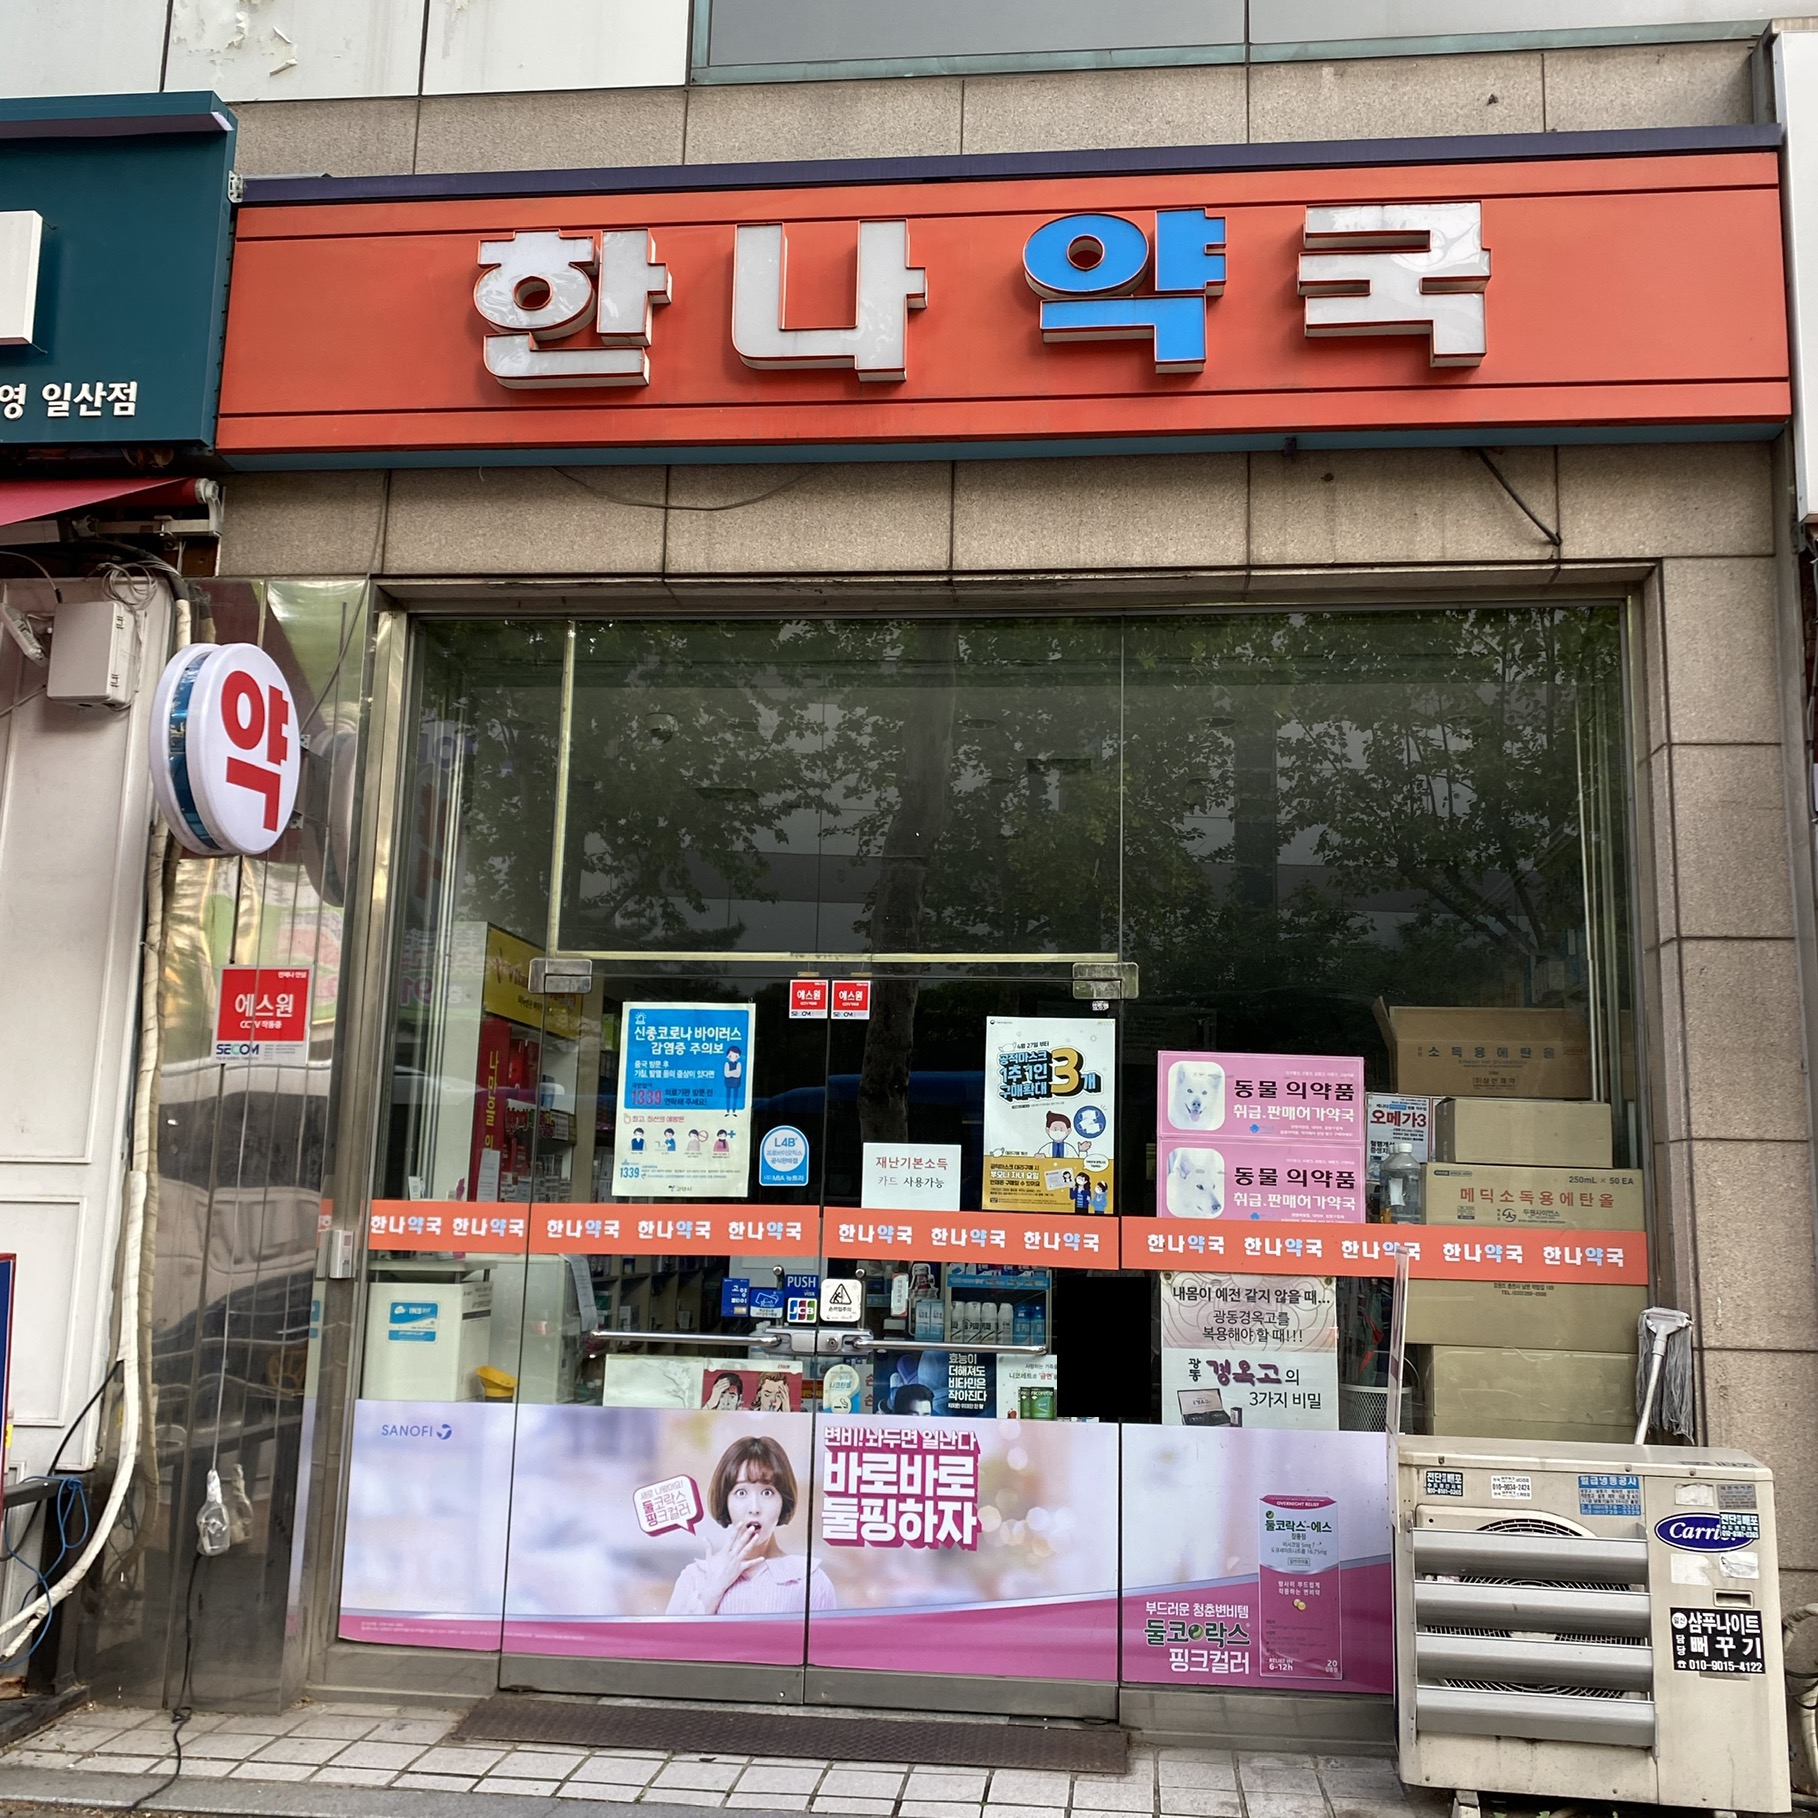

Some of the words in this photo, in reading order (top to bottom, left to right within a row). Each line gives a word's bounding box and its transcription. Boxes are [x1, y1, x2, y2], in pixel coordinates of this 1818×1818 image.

[42, 380, 137, 417] 일산점
[221, 670, 289, 832] 약
[796, 989, 821, 1001] 에스원
[838, 990, 863, 1001] 에스원
[234, 993, 294, 1018] 에스원
[261, 1020, 282, 1029] 작동중
[634, 1026, 693, 1041] 신종코로나
[694, 1026, 742, 1041] 바이러스
[216, 1043, 260, 1055] SECOM
[651, 1042, 686, 1055] 감염증
[689, 1042, 724, 1055] 주의보
[999, 1050, 1048, 1065] 공적마스크
[696, 1070, 715, 1079] 있다면
[1025, 1063, 1048, 1080] 1인
[631, 1089, 662, 1106] 1339
[999, 1081, 1047, 1099] 구매확대
[1234, 1079, 1278, 1099] 동물
[1285, 1081, 1355, 1102] 의약품
[1233, 1104, 1355, 1123] 취급.판매허가약국
[1370, 1109, 1427, 1128] 오메가3
[774, 1137, 796, 1148] L4B
[875, 1156, 949, 1170] 재난기본소득
[619, 1167, 640, 1179] 1339
[1234, 1167, 1279, 1187] 동물
[1286, 1168, 1356, 1189] 의약품
[1568, 1175, 1598, 1184] 250mL
[1622, 1177, 1634, 1185] EA
[903, 1176, 945, 1189] 사용가능
[1233, 1191, 1356, 1211] 취급.판매허가약국
[370, 1215, 442, 1235] 한나약국
[452, 1217, 525, 1238] 한나약국
[547, 1219, 620, 1239] 한나약국
[637, 1219, 711, 1240] 한나약국
[728, 1221, 802, 1241] 한나약국
[838, 1223, 913, 1245] 한나약국
[931, 1227, 1006, 1248] 한나약국
[1023, 1230, 1100, 1253] 한나약국
[1148, 1234, 1225, 1255] 한나약국
[1243, 1236, 1323, 1258] 한나약국
[1341, 1239, 1421, 1262] 한나약국
[1442, 1242, 1523, 1265] 한나약국
[1543, 1245, 1624, 1268] 한나약국
[787, 1276, 817, 1288] PUSH
[1173, 1286, 1211, 1303] 내몸이
[1215, 1287, 1241, 1303] 예전
[1244, 1288, 1270, 1304] 같지
[1274, 1289, 1301, 1305] 않을
[789, 1303, 816, 1318] JCB
[1213, 1309, 1290, 1327] 광동경옥고를
[1202, 1326, 1254, 1342] 복용해야
[1256, 1327, 1269, 1343] 할
[1272, 1328, 1303, 1343] 때!!!
[948, 1353, 977, 1365] 효능이
[948, 1365, 986, 1377] 더해져도
[948, 1377, 987, 1390] 비타민은
[948, 1390, 987, 1402] 작아진다
[1249, 1391, 1288, 1409] 3가지
[1292, 1392, 1322, 1410] 비밀
[381, 1424, 433, 1437] SANOFI
[922, 1429, 977, 1451] 일난다
[823, 1451, 976, 1498] 바로바로
[642, 1490, 688, 1515] 둘코락스
[645, 1502, 691, 1527] 핑크컬러
[821, 1496, 977, 1545] 둘핑하자
[1669, 1521, 1736, 1541] Carri
[1145, 1601, 1190, 1617] 부드러운
[1192, 1602, 1249, 1619] 청춘변비템
[1688, 1611, 1761, 1636] 샴푸나이트
[1144, 1619, 1250, 1648] 둘코락스
[1675, 1634, 1687, 1656] 담당
[1690, 1635, 1762, 1659] 뻐꾸기
[1169, 1648, 1250, 1675] 핑크컬러
[1269, 1663, 1294, 1671] 6-12h
[1327, 1659, 1338, 1667] 20
[1689, 1659, 1763, 1673] 010-9015-4122
